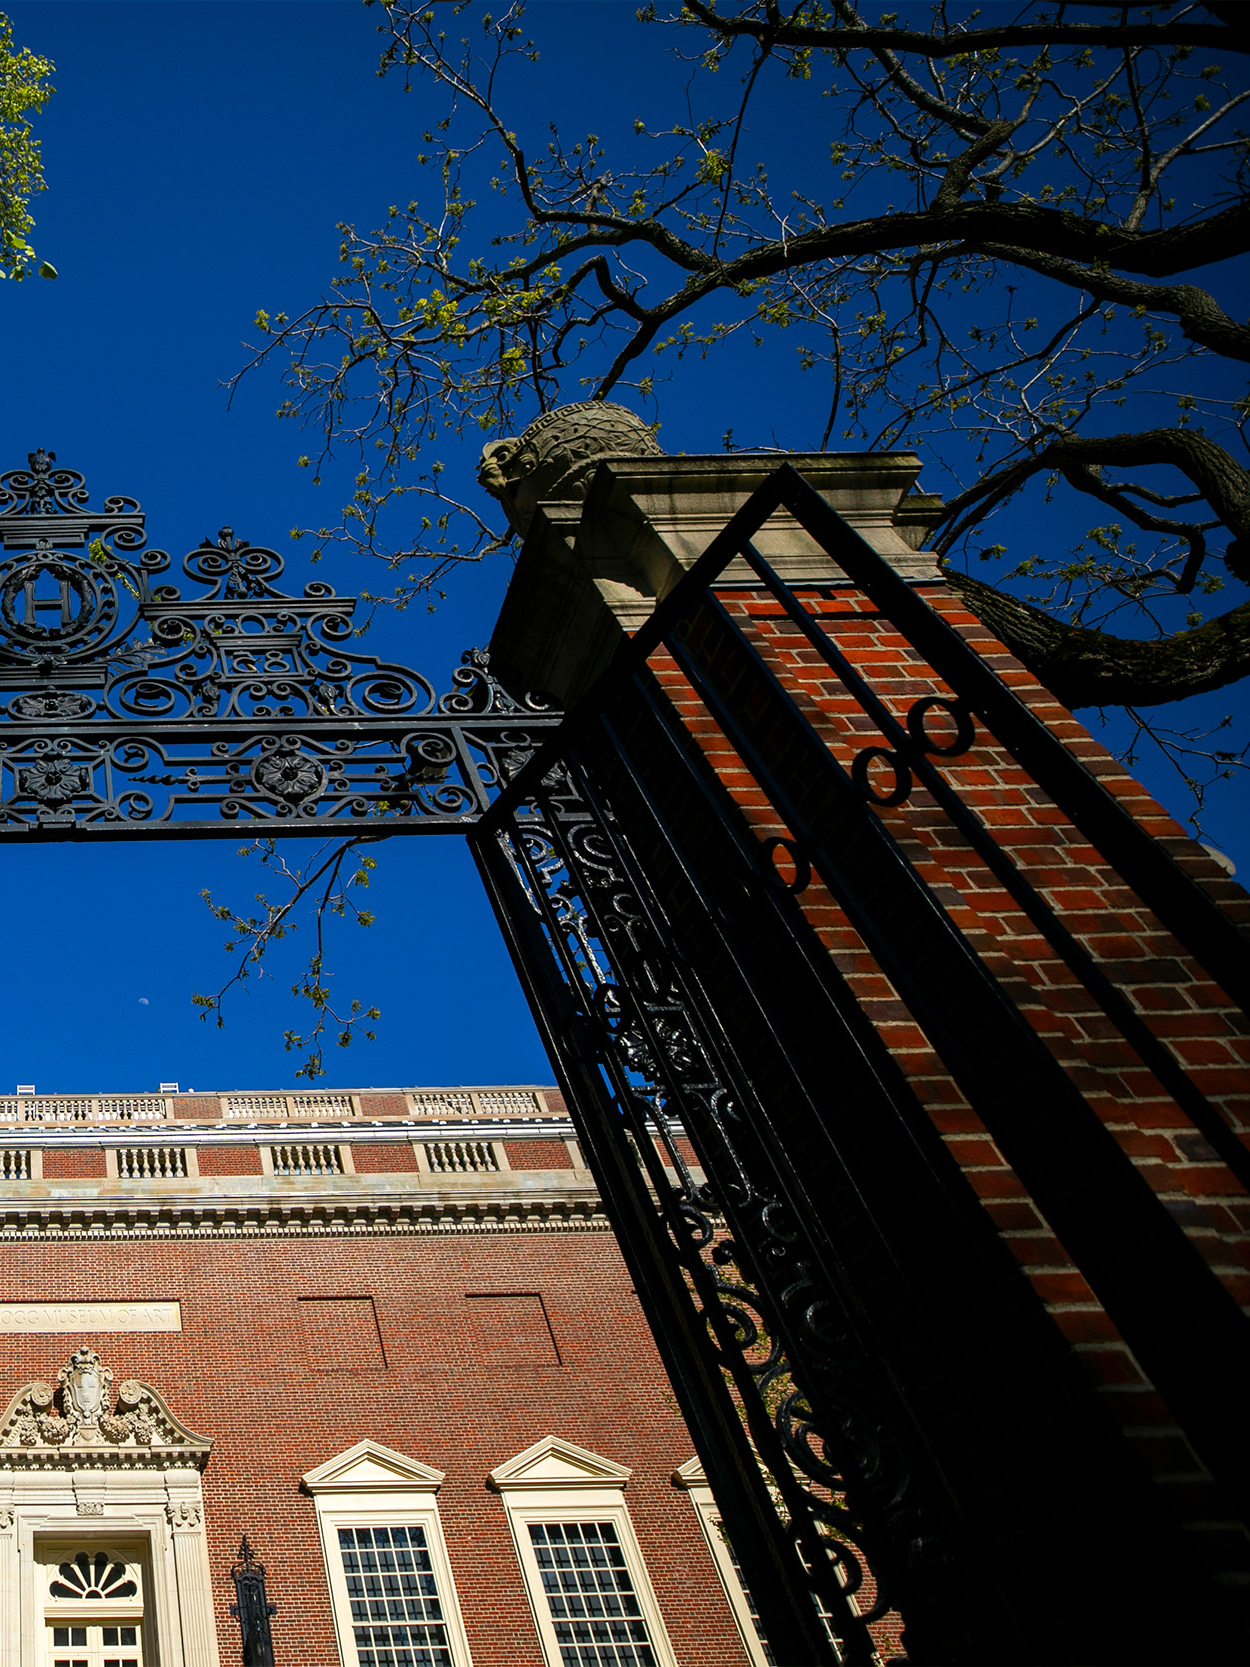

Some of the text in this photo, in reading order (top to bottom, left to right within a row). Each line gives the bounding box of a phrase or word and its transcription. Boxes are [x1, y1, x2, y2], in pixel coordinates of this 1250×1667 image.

[24, 580, 72, 624] H
[43, 1309, 113, 1325] MUSEUM
[117, 1309, 139, 1324] OF
[142, 1308, 173, 1324] ART
